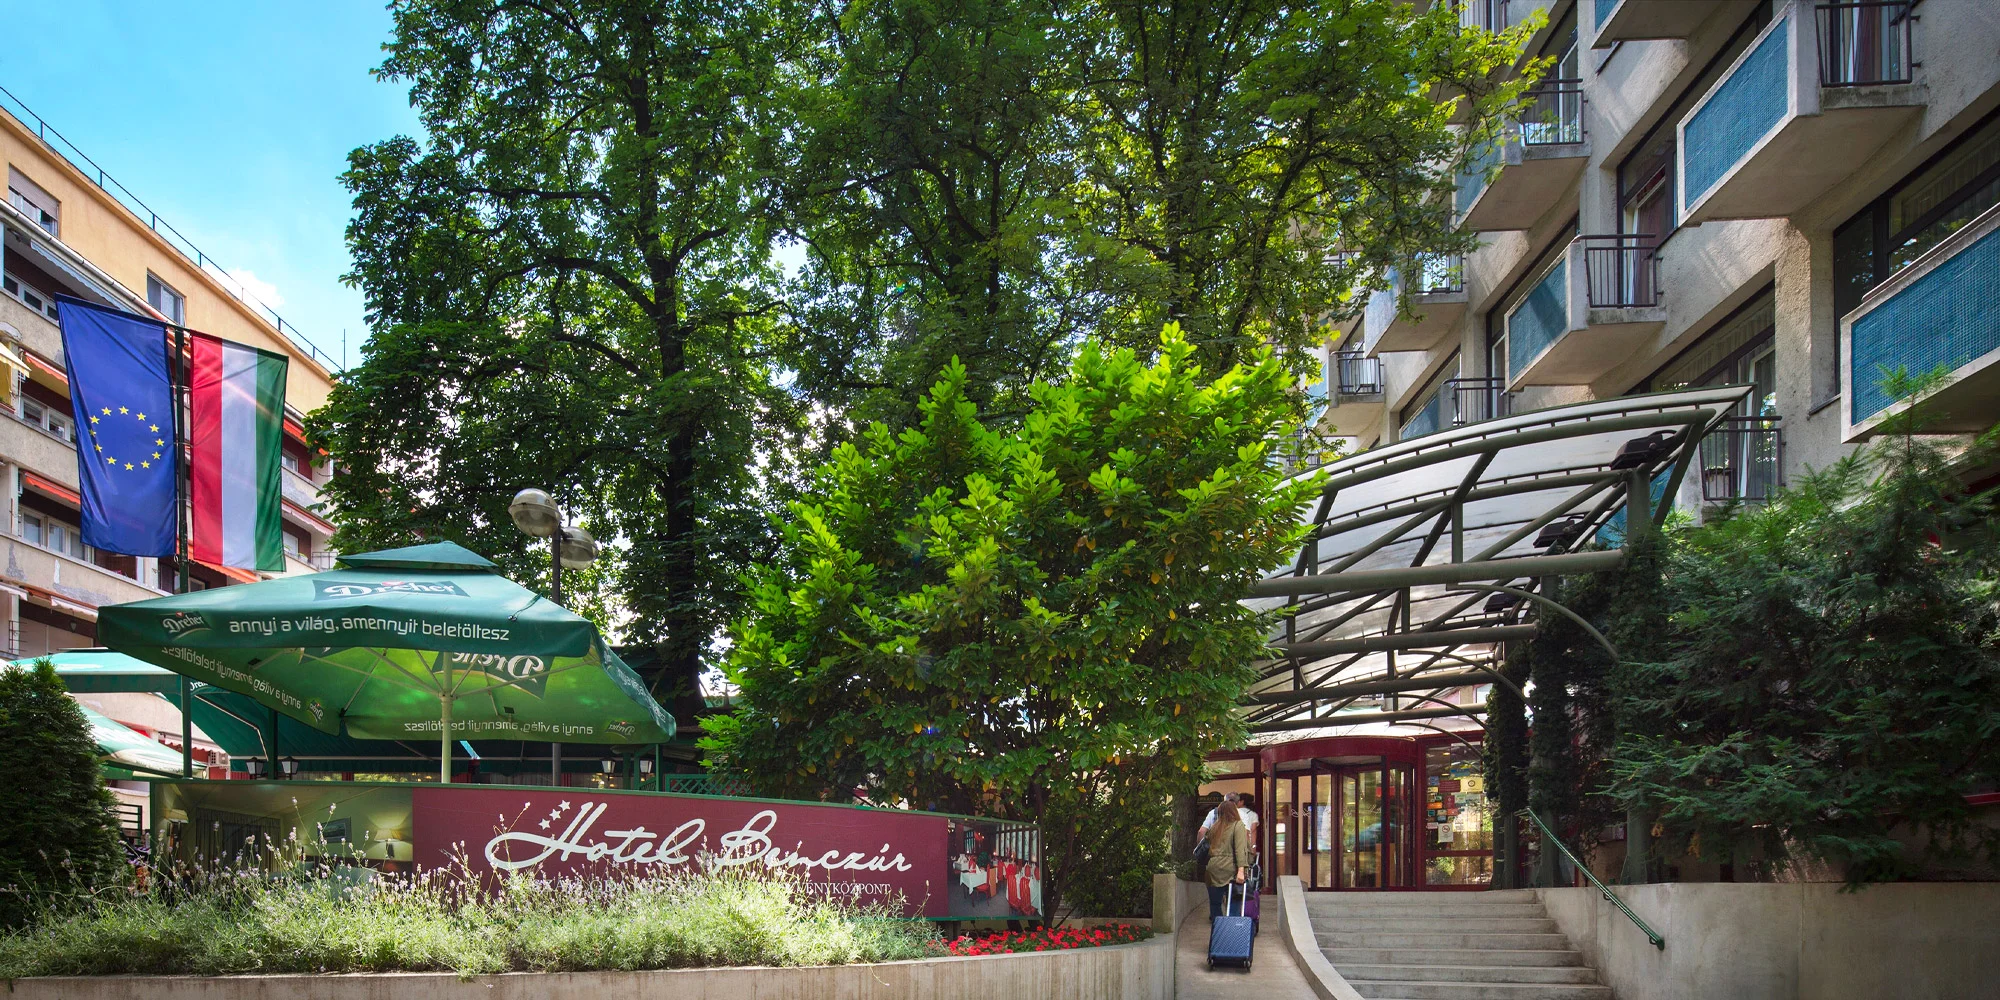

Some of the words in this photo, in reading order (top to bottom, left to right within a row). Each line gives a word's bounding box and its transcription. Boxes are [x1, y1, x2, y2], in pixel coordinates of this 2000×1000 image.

[323, 582, 454, 597] Dreher
[162, 613, 204, 634] Dreher
[229, 617, 277, 636] annyi
[280, 619, 292, 632] a
[294, 616, 339, 634] világ,
[341, 617, 418, 636] amennyit
[422, 621, 509, 641] beletöltesz
[484, 801, 706, 870] Hotel
[713, 809, 912, 876] Benczúr
